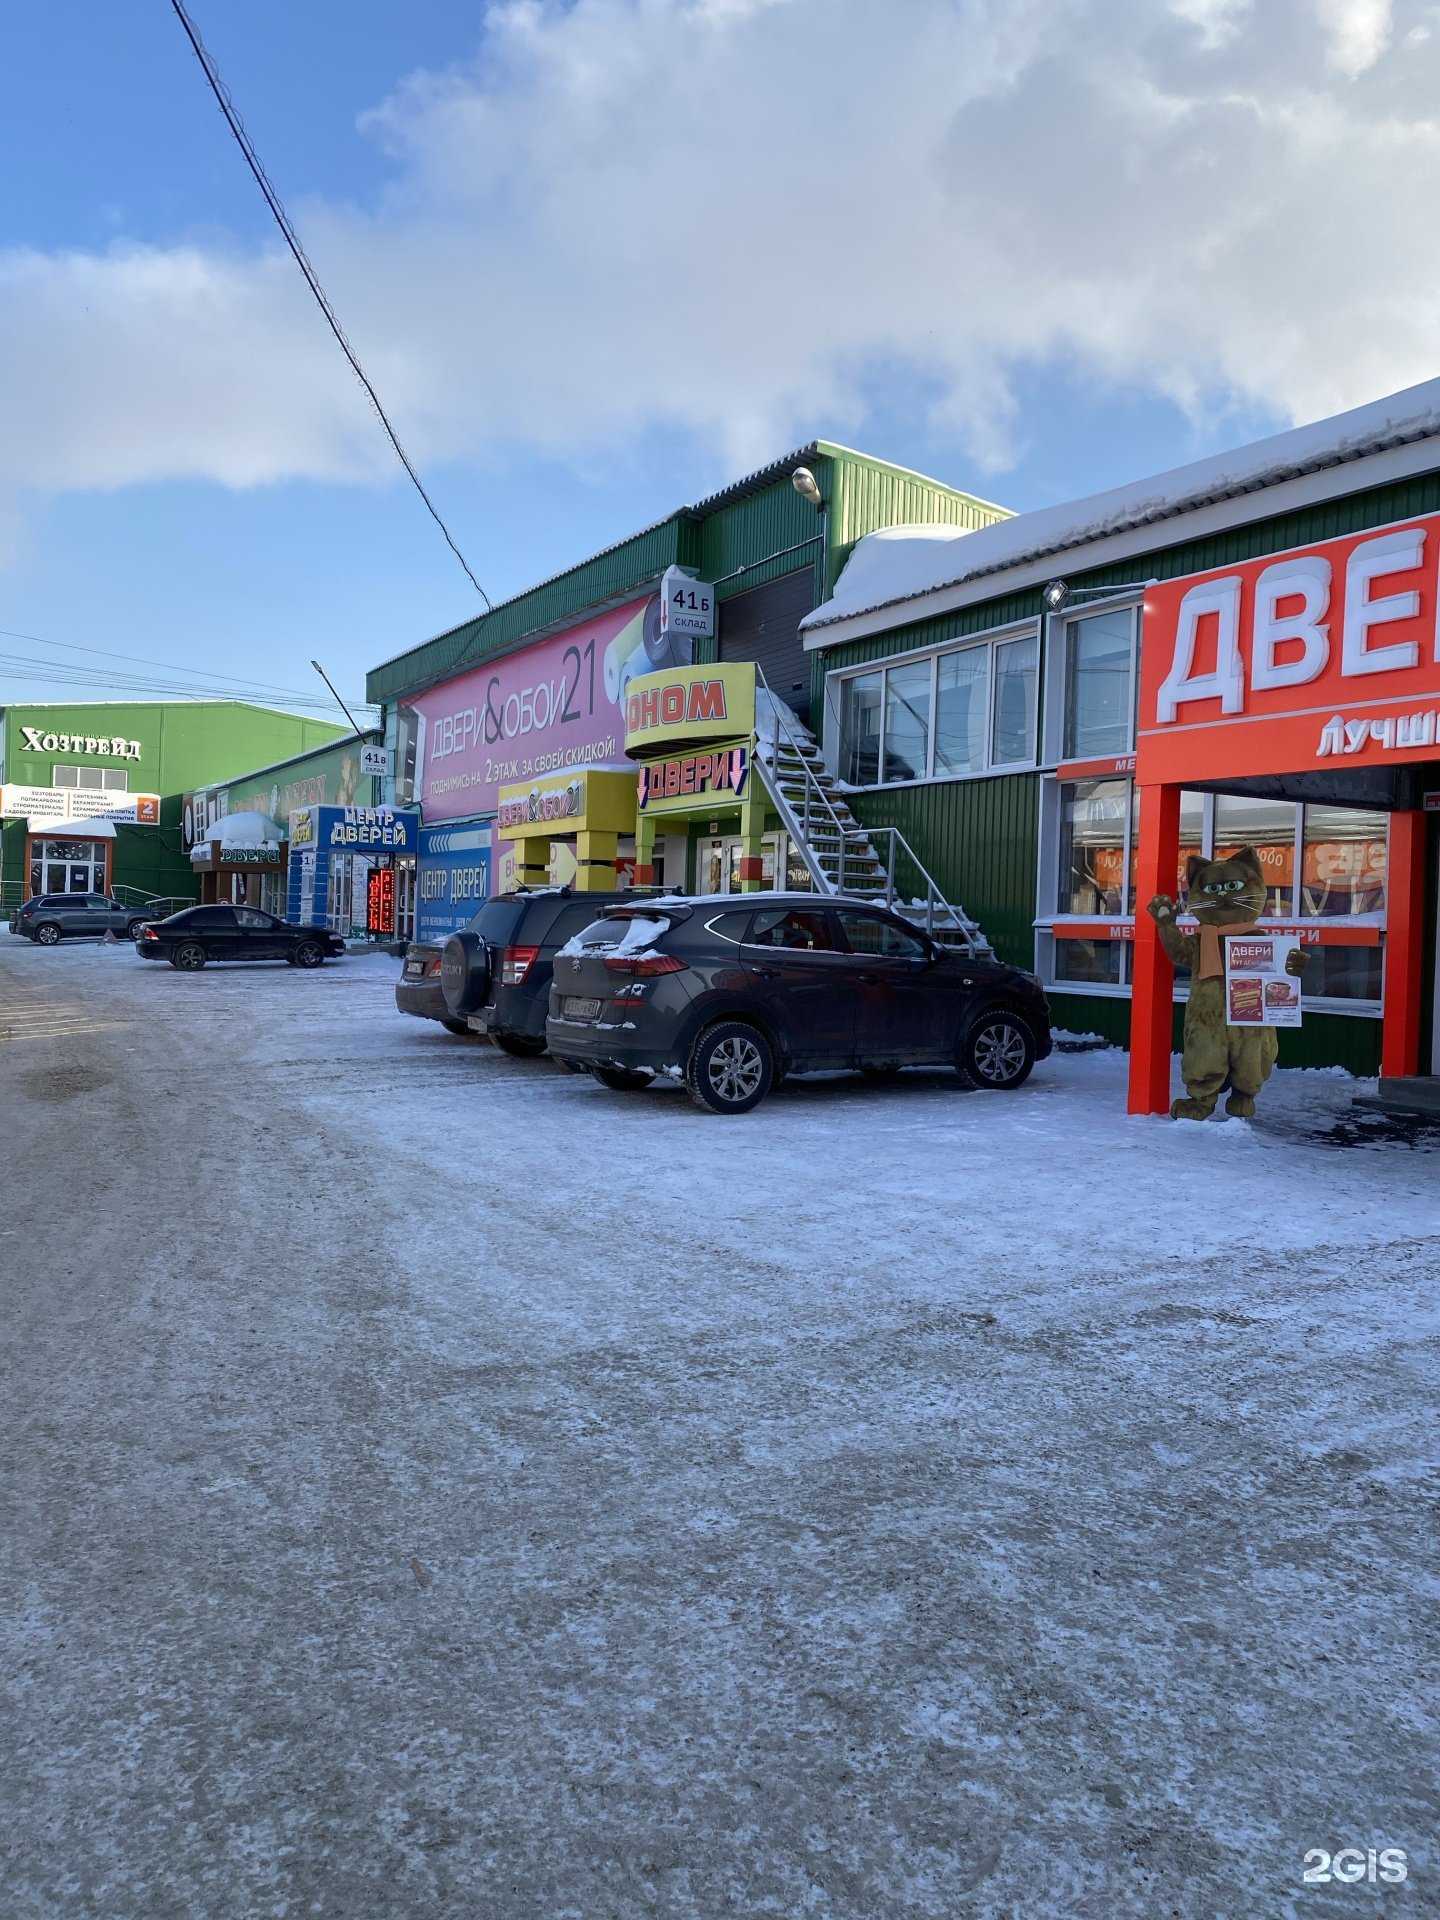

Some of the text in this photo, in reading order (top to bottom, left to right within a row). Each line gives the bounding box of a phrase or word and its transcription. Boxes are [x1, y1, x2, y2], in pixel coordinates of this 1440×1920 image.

[1156, 528, 1440, 723] ДВЕ
[627, 680, 727, 732] ОНОМ
[1316, 711, 1440, 757] ЛУЧШ
[521, 762, 533, 775] ЗА
[534, 747, 563, 773] СВОЕЙ
[565, 736, 616, 766] СКИДКОЙ!
[648, 751, 730, 799] ДВЕРИ
[1115, 758, 1136, 771] МЕ
[142, 801, 153, 815] 2
[345, 807, 393, 825] ЦЕНТР
[331, 821, 406, 845] ДВЕРЕЙ
[421, 869, 447, 904] ЦЕНТР
[450, 860, 487, 904] ДВЕРЕЙ
[1231, 946, 1272, 957] ДВЕРИ
